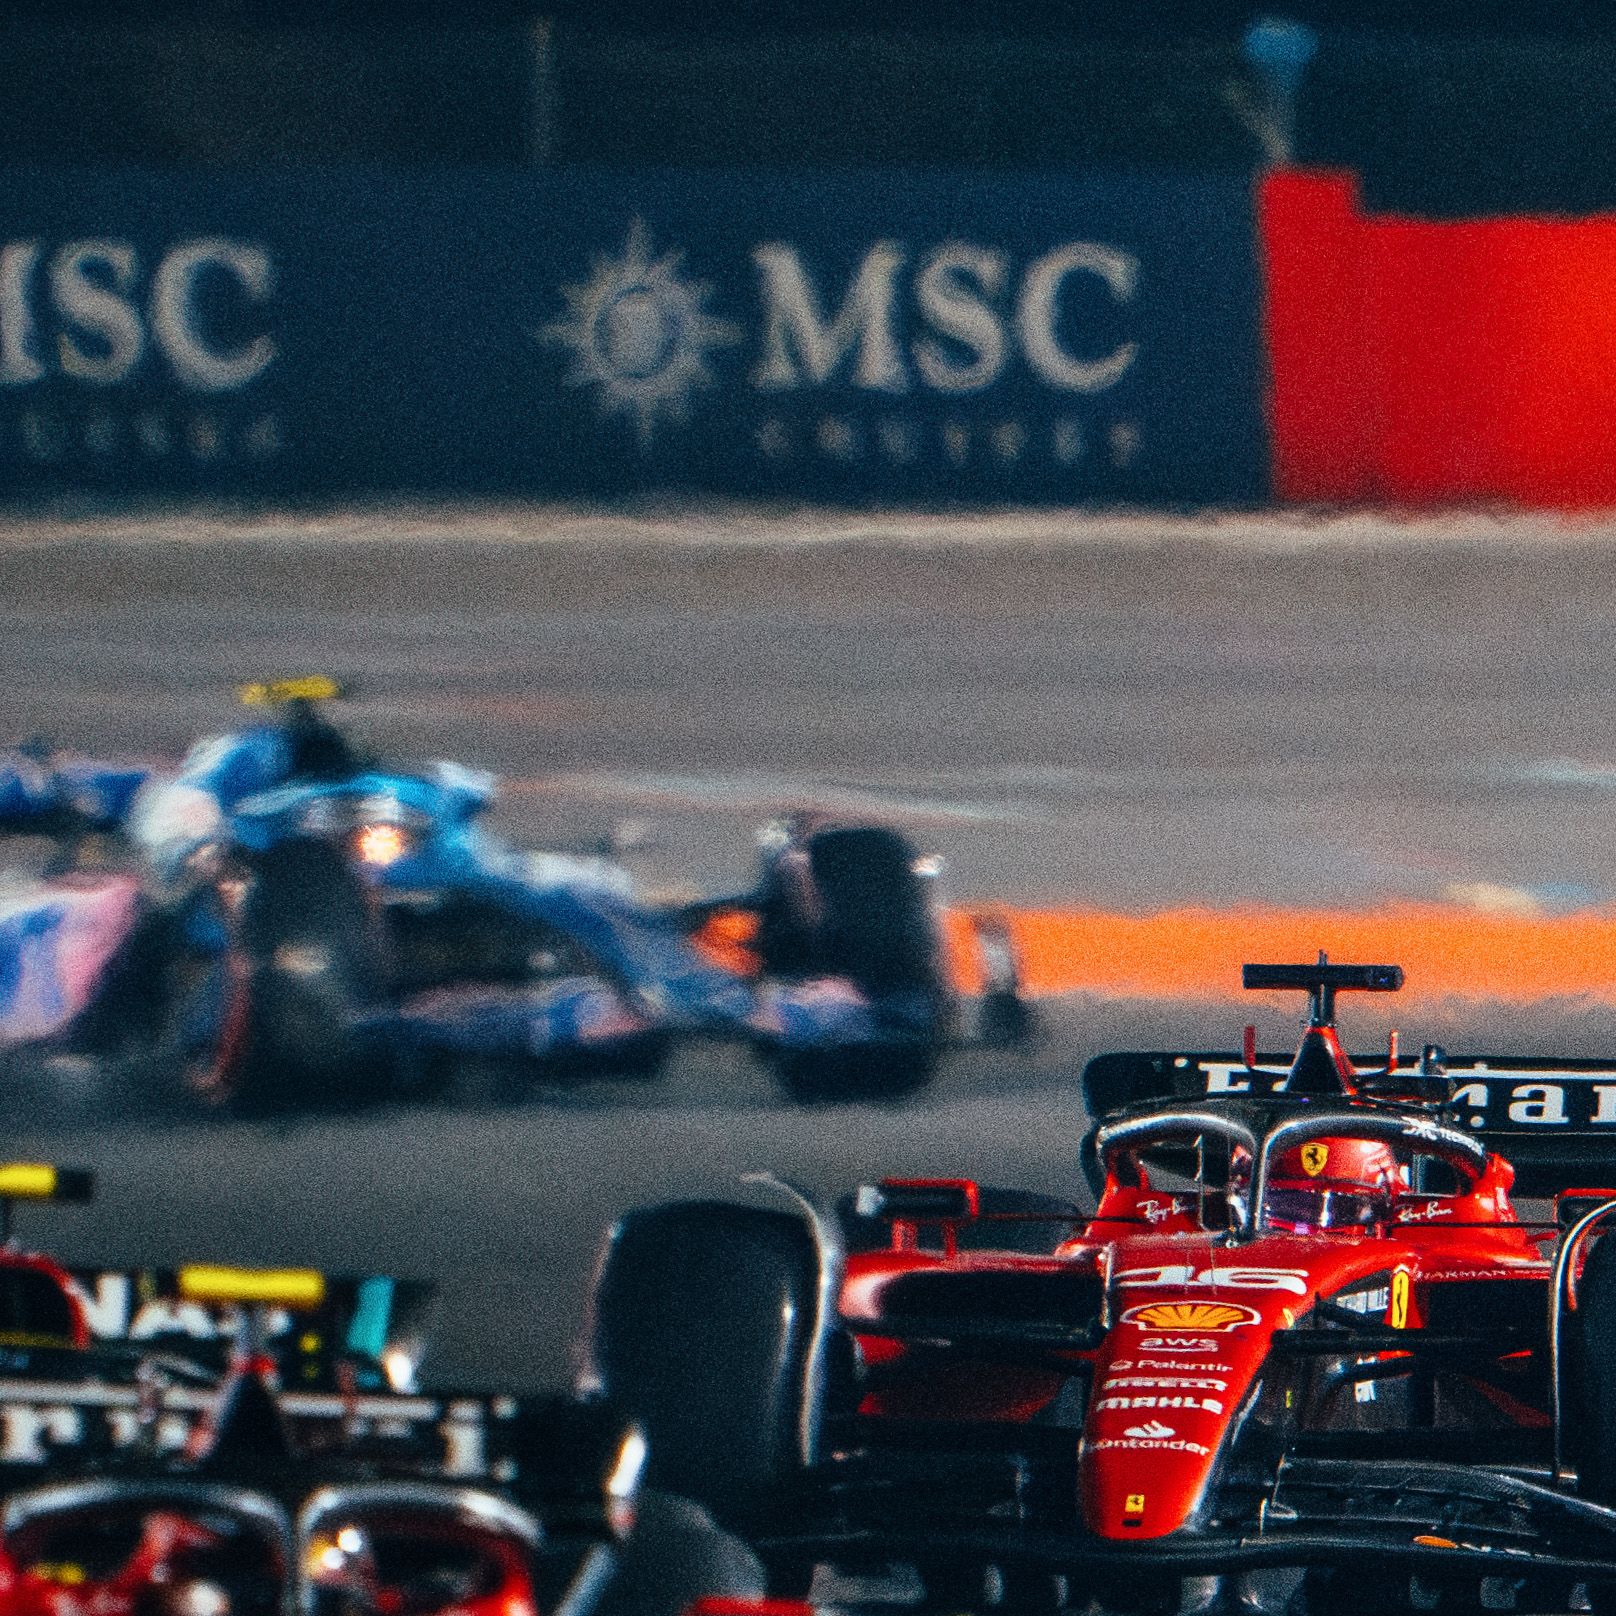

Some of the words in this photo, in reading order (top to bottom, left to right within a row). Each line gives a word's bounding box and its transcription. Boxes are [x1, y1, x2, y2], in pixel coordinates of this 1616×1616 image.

[752, 238, 1139, 394] MSC
[1112, 1265, 1310, 1295] 16
[1139, 1337, 1219, 1348] aws
[1137, 1360, 1234, 1372] Palantir
[1096, 1396, 1223, 1415] MAHLE
